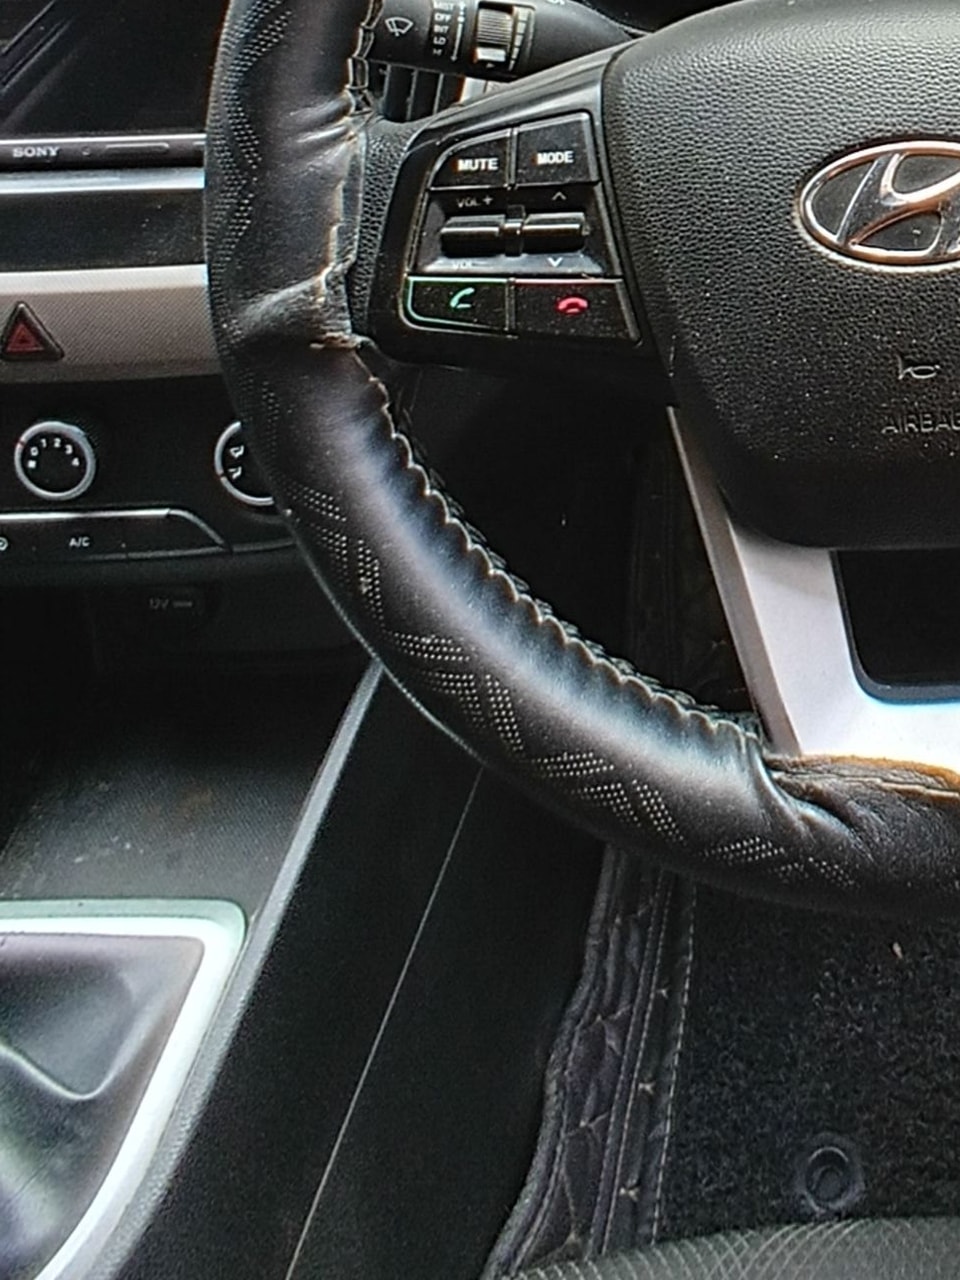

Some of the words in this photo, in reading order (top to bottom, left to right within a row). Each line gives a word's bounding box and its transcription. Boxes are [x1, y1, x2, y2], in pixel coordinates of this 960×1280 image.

[434, 12, 452, 23] OFF
[433, 36, 447, 45] LO
[12, 145, 61, 159] SONY
[457, 158, 499, 171] MUTE
[536, 150, 575, 165] MODE
[40, 437, 47, 448] 1
[53, 437, 61, 448] 2
[30, 446, 39, 457] 0
[65, 444, 73, 455] 3
[71, 457, 80, 467] 4
[68, 536, 91, 548] A/C
